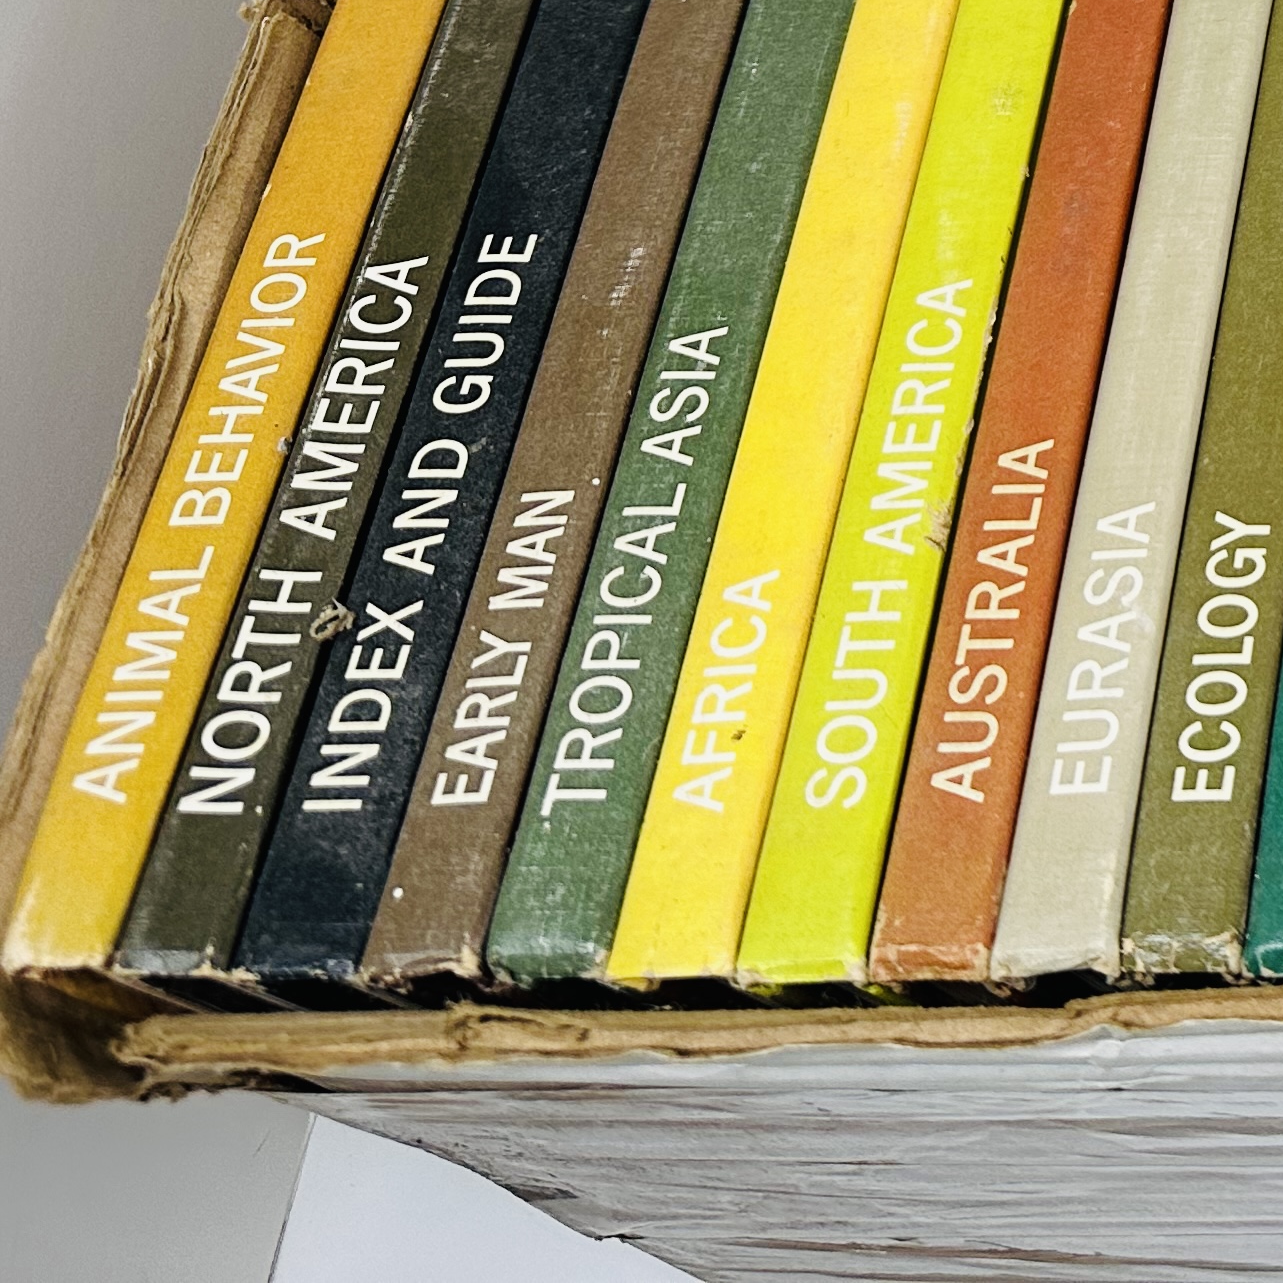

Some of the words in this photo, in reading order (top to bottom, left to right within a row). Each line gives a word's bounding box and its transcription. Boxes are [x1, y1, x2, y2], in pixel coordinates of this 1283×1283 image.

[72, 545, 215, 803] ANIMAL
[169, 232, 326, 527] BEHAVIOR
[177, 567, 323, 814] NORTH
[279, 255, 430, 541] AMERICA
[303, 599, 424, 811] INDEX
[382, 439, 469, 574] AND
[432, 233, 538, 413] GUIDE
[431, 629, 532, 806] EARLY
[488, 489, 576, 609] MAN
[541, 482, 686, 816] TROPICAL
[639, 325, 729, 466] ASIA
[672, 570, 781, 812] AFRICA
[805, 579, 908, 809] SOUTH
[864, 278, 973, 554] AMERICA
[930, 438, 1055, 803] AUSTRALIA
[1049, 501, 1156, 795] EURASIA
[1171, 510, 1272, 802] ECOLOGY
